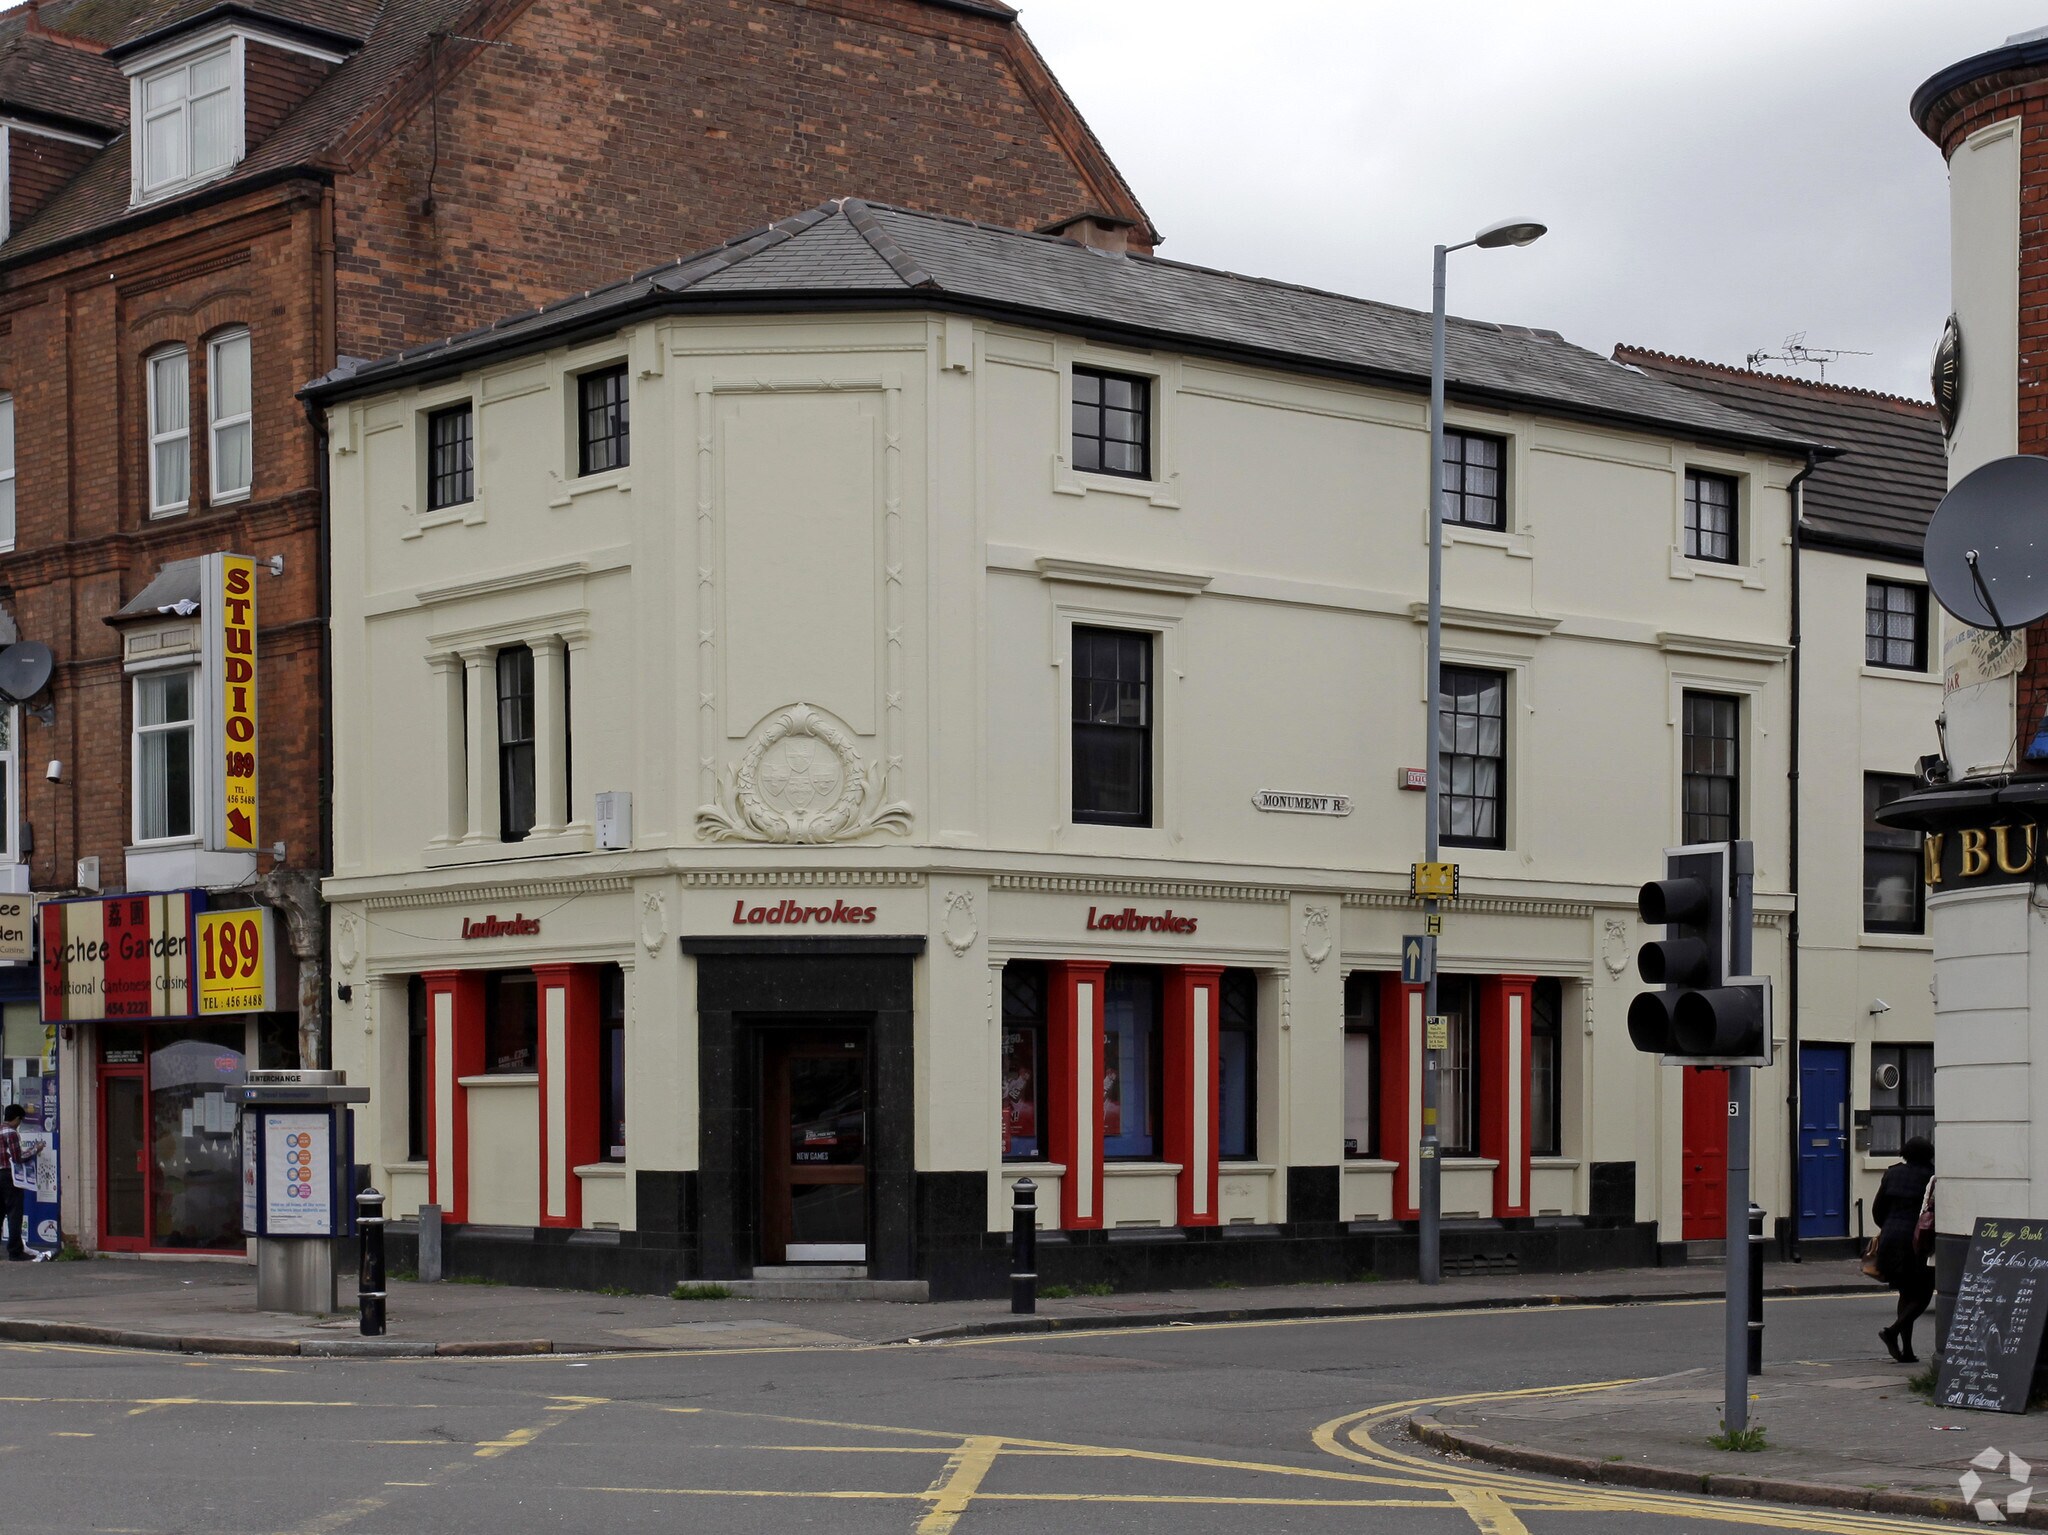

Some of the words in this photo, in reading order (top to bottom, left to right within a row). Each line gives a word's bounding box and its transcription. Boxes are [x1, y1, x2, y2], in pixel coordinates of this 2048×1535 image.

[225, 568, 255, 742] STUDIO
[226, 751, 255, 778] 189
[227, 795, 239, 804] 456
[240, 796, 255, 805] 5488
[1263, 794, 1328, 811] MONUMENT
[1958, 823, 2048, 877] BU
[733, 899, 877, 925] Ladbrokes
[1087, 906, 1198, 934] Ladbrokes
[461, 913, 540, 940] Ladbrokes
[1428, 915, 1441, 934] H
[43, 935, 110, 971] Lychee
[120, 931, 188, 960] Garden
[203, 919, 259, 979] 189
[45, 976, 96, 996] Traditional
[101, 978, 151, 994] Cantonese
[156, 975, 188, 991] Cuisine
[204, 997, 218, 1010] TEL
[226, 996, 240, 1008] 456
[243, 994, 262, 1007] 5488
[1729, 1102, 1738, 1115] 5
[796, 1151, 809, 1161] NEW
[810, 1151, 828, 1161] GAMES
[1981, 1222, 1998, 1238] The
[2018, 1225, 2043, 1240] Bush
[2005, 1250, 2026, 1267] Now
[1947, 1391, 1965, 1405] All
[1967, 1393, 2001, 1409] Welcome
